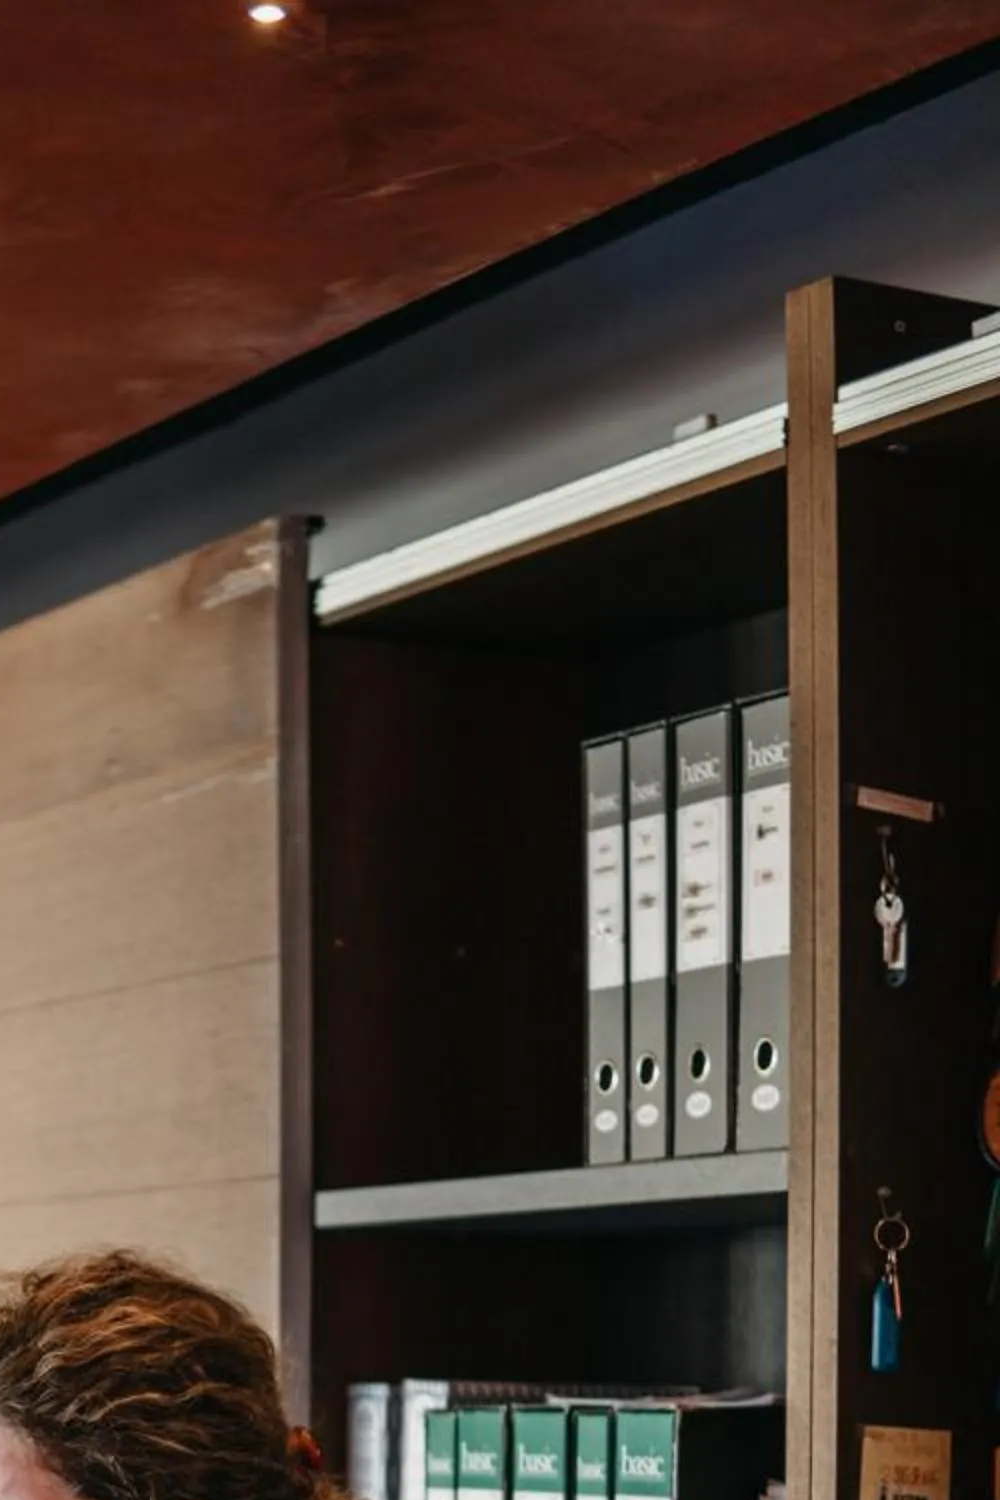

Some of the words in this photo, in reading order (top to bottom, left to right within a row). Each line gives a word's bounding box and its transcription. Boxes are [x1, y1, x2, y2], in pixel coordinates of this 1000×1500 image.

[679, 753, 720, 785] basic
[518, 1443, 557, 1476] basic
[620, 1444, 664, 1479] basic
